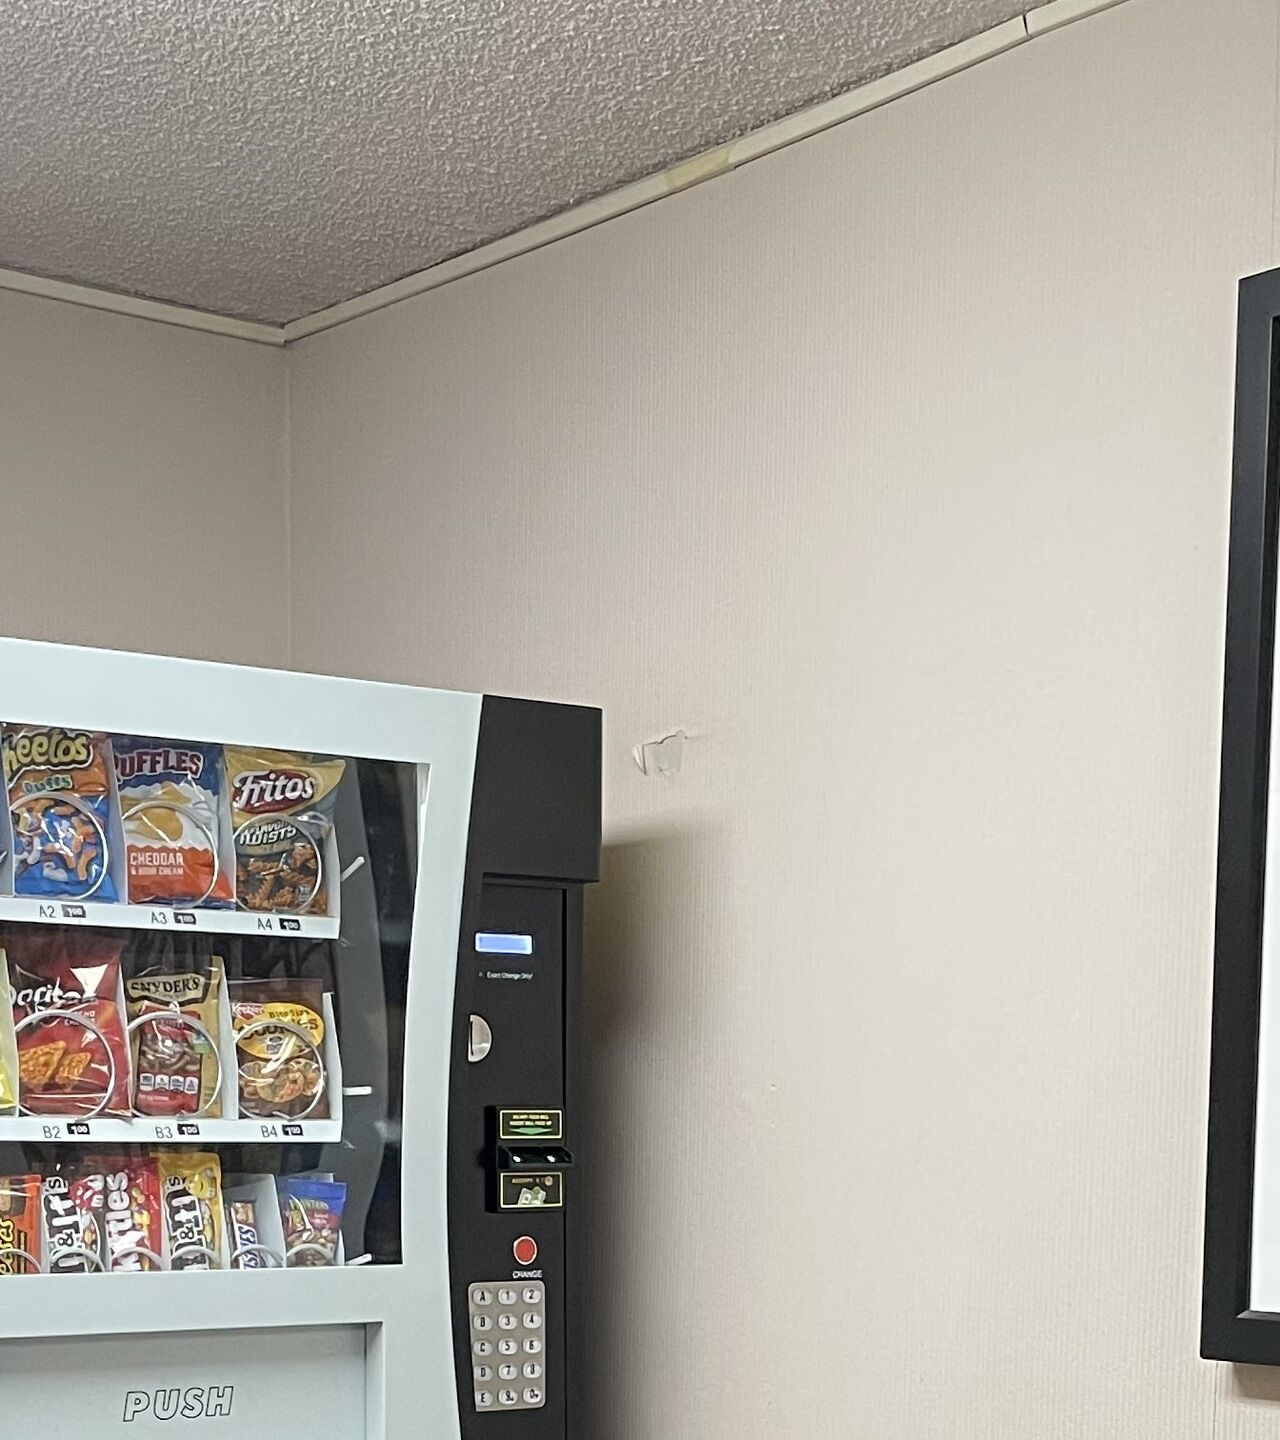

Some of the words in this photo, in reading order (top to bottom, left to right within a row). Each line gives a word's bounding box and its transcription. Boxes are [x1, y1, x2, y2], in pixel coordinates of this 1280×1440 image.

[232, 769, 315, 809] Fritos
[130, 852, 183, 866] CHEDDAR
[39, 904, 56, 918] A2
[151, 911, 168, 925] A3
[257, 917, 273, 931] A4
[130, 976, 201, 994] SNYDER'S
[43, 1126, 62, 1139] B2
[155, 1126, 173, 1139] B3
[261, 1126, 278, 1138] B4
[512, 1270, 543, 1279] CHANGE
[479, 1291, 486, 1302] A
[528, 1289, 535, 1300] 2
[479, 1316, 486, 1327] B
[504, 1315, 511, 1326] 3
[528, 1314, 534, 1324] 4
[479, 1342, 486, 1353] C
[504, 1340, 511, 1351] 5
[528, 1339, 534, 1350] 6
[480, 1367, 486, 1378] D
[505, 1365, 511, 1376] 7
[529, 1363, 535, 1375] 8
[123, 1386, 234, 1423] PUSH
[480, 1392, 486, 1403] E
